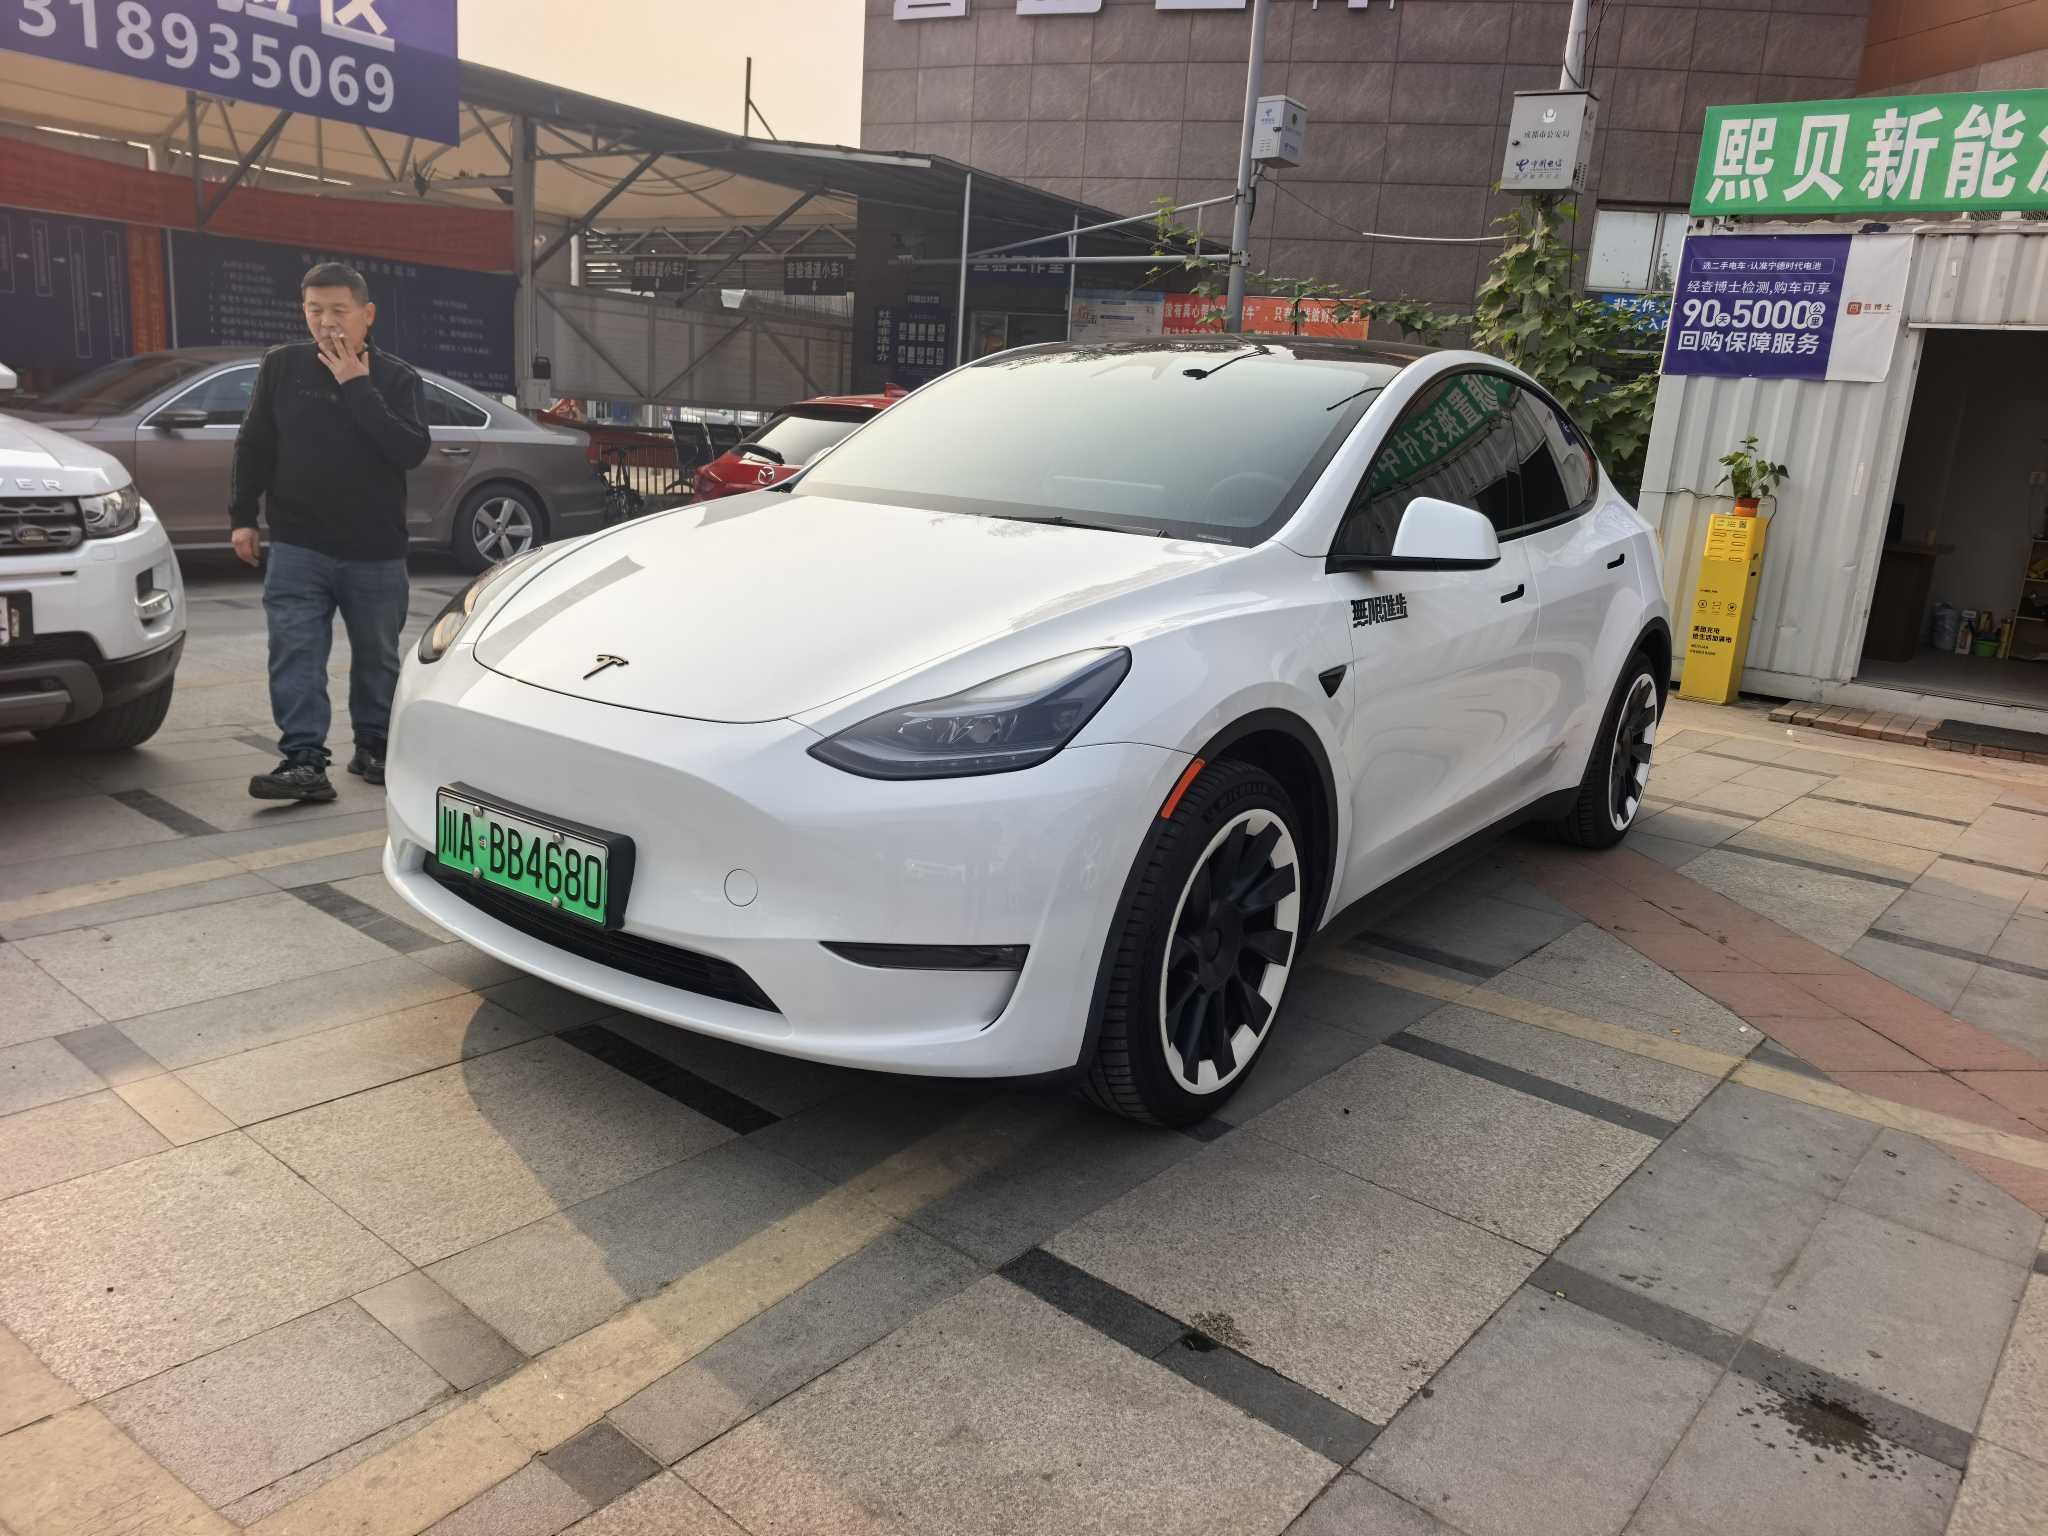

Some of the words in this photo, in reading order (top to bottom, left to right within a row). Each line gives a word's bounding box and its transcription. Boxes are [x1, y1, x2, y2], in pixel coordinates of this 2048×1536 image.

[1678, 331, 1820, 354] 回购保障服务
